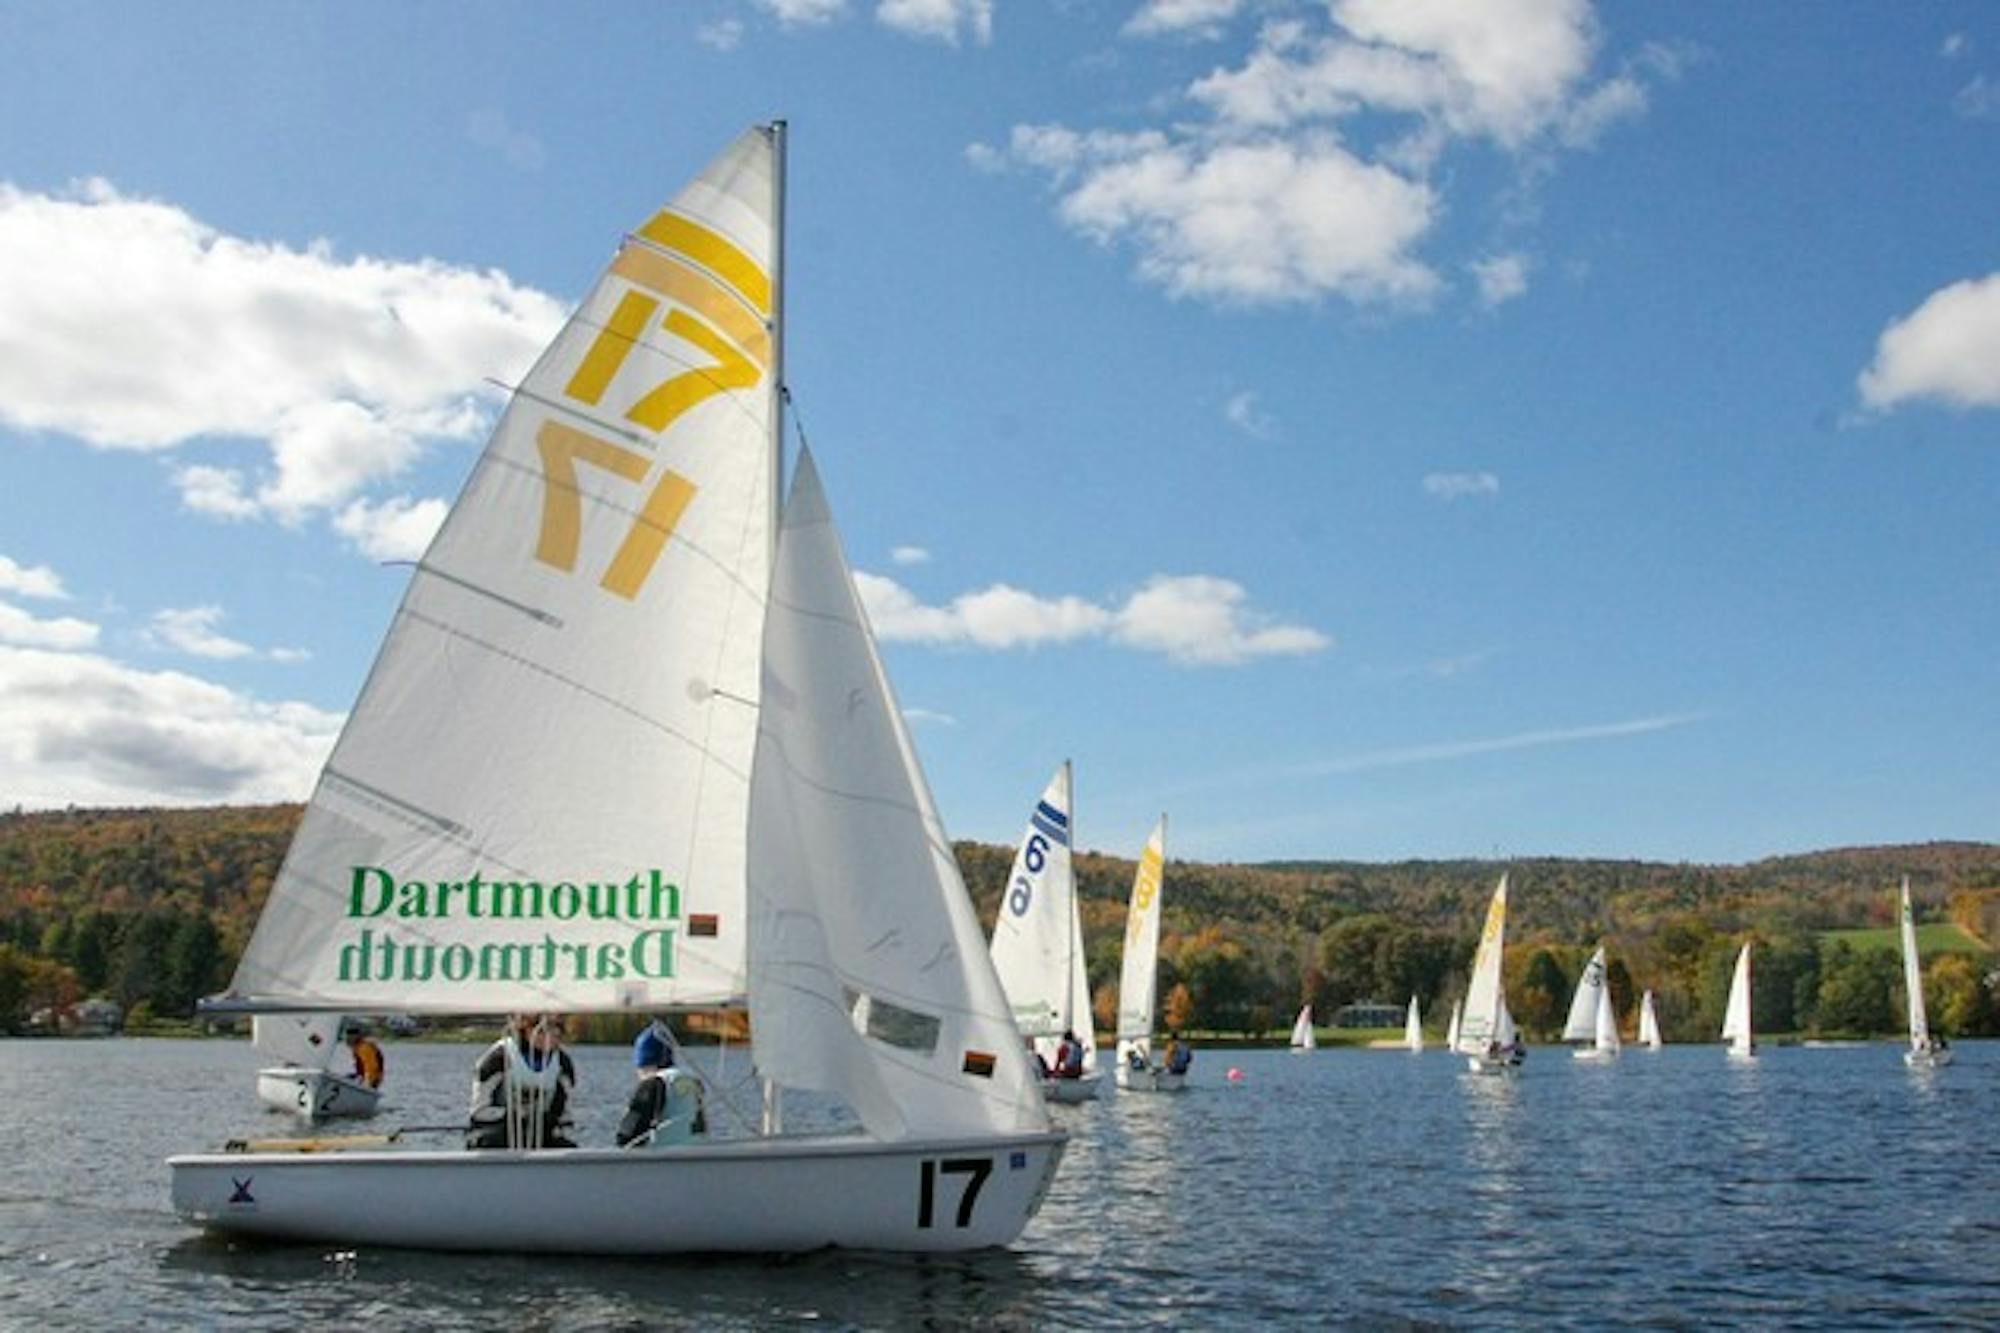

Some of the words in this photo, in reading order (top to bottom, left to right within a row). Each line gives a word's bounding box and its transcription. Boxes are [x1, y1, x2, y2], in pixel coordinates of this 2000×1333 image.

[564, 288, 764, 434] 17
[1026, 835, 1050, 872] 6
[345, 865, 681, 921] Dartmouth
[918, 1158, 993, 1229] 17
